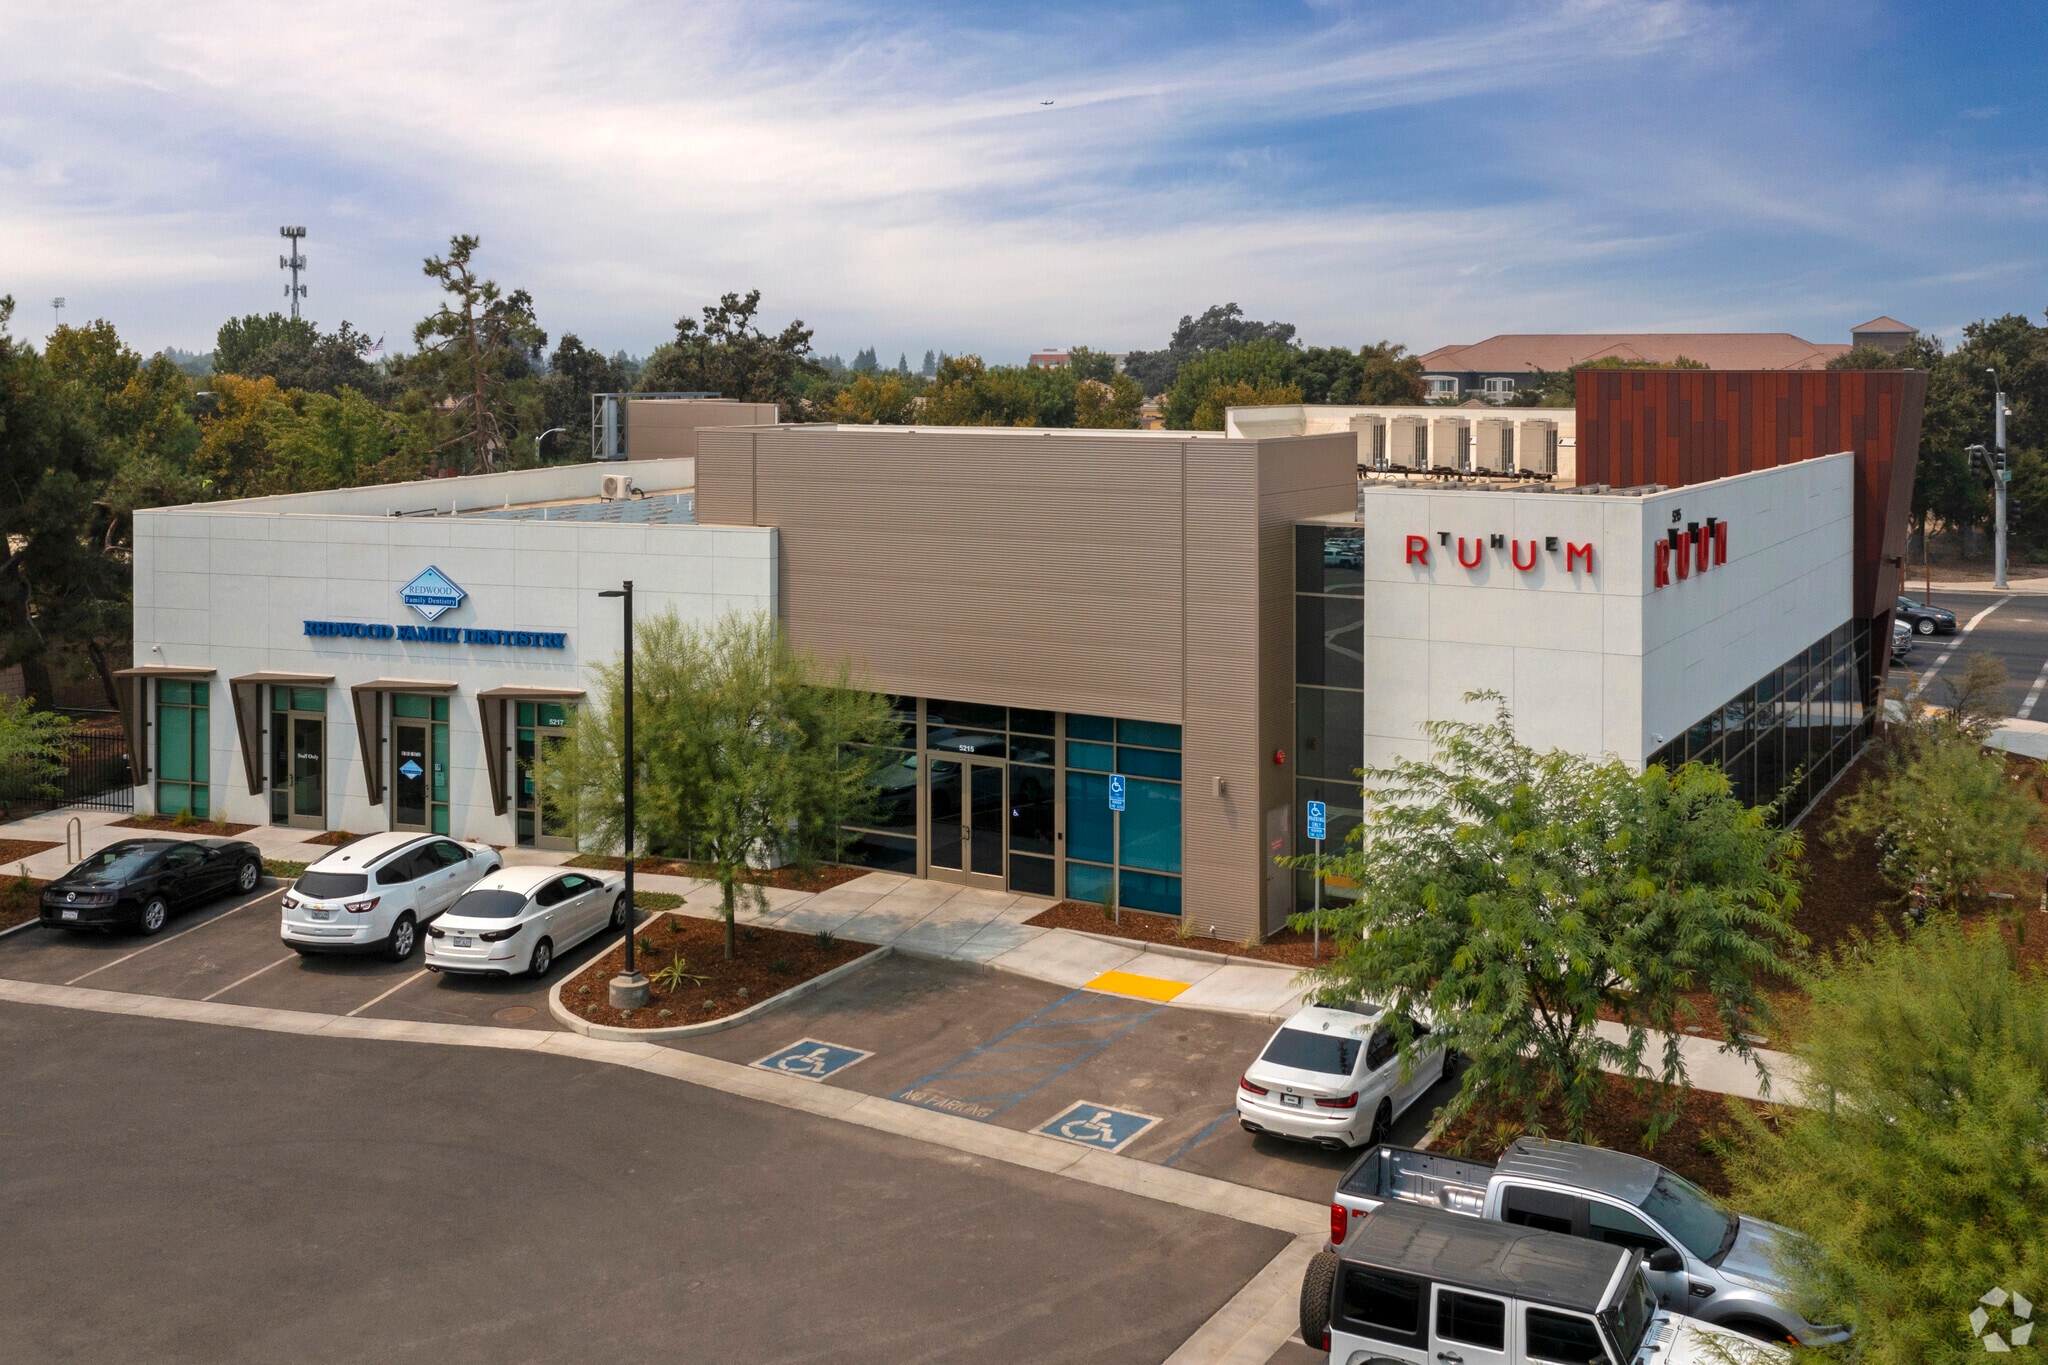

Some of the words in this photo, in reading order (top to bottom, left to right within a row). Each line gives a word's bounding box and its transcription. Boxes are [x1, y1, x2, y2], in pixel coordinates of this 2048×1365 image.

[409, 585, 452, 595] REDWOOD
[405, 596, 426, 605] Family
[427, 597, 456, 606] Dentistry
[303, 620, 394, 640] REDWOOD
[396, 625, 461, 643] FAMILY
[463, 629, 567, 648] DENTISTRY
[959, 744, 975, 752] 5215
[900, 1090, 927, 1101] NO
[924, 1095, 994, 1117] PARKING
